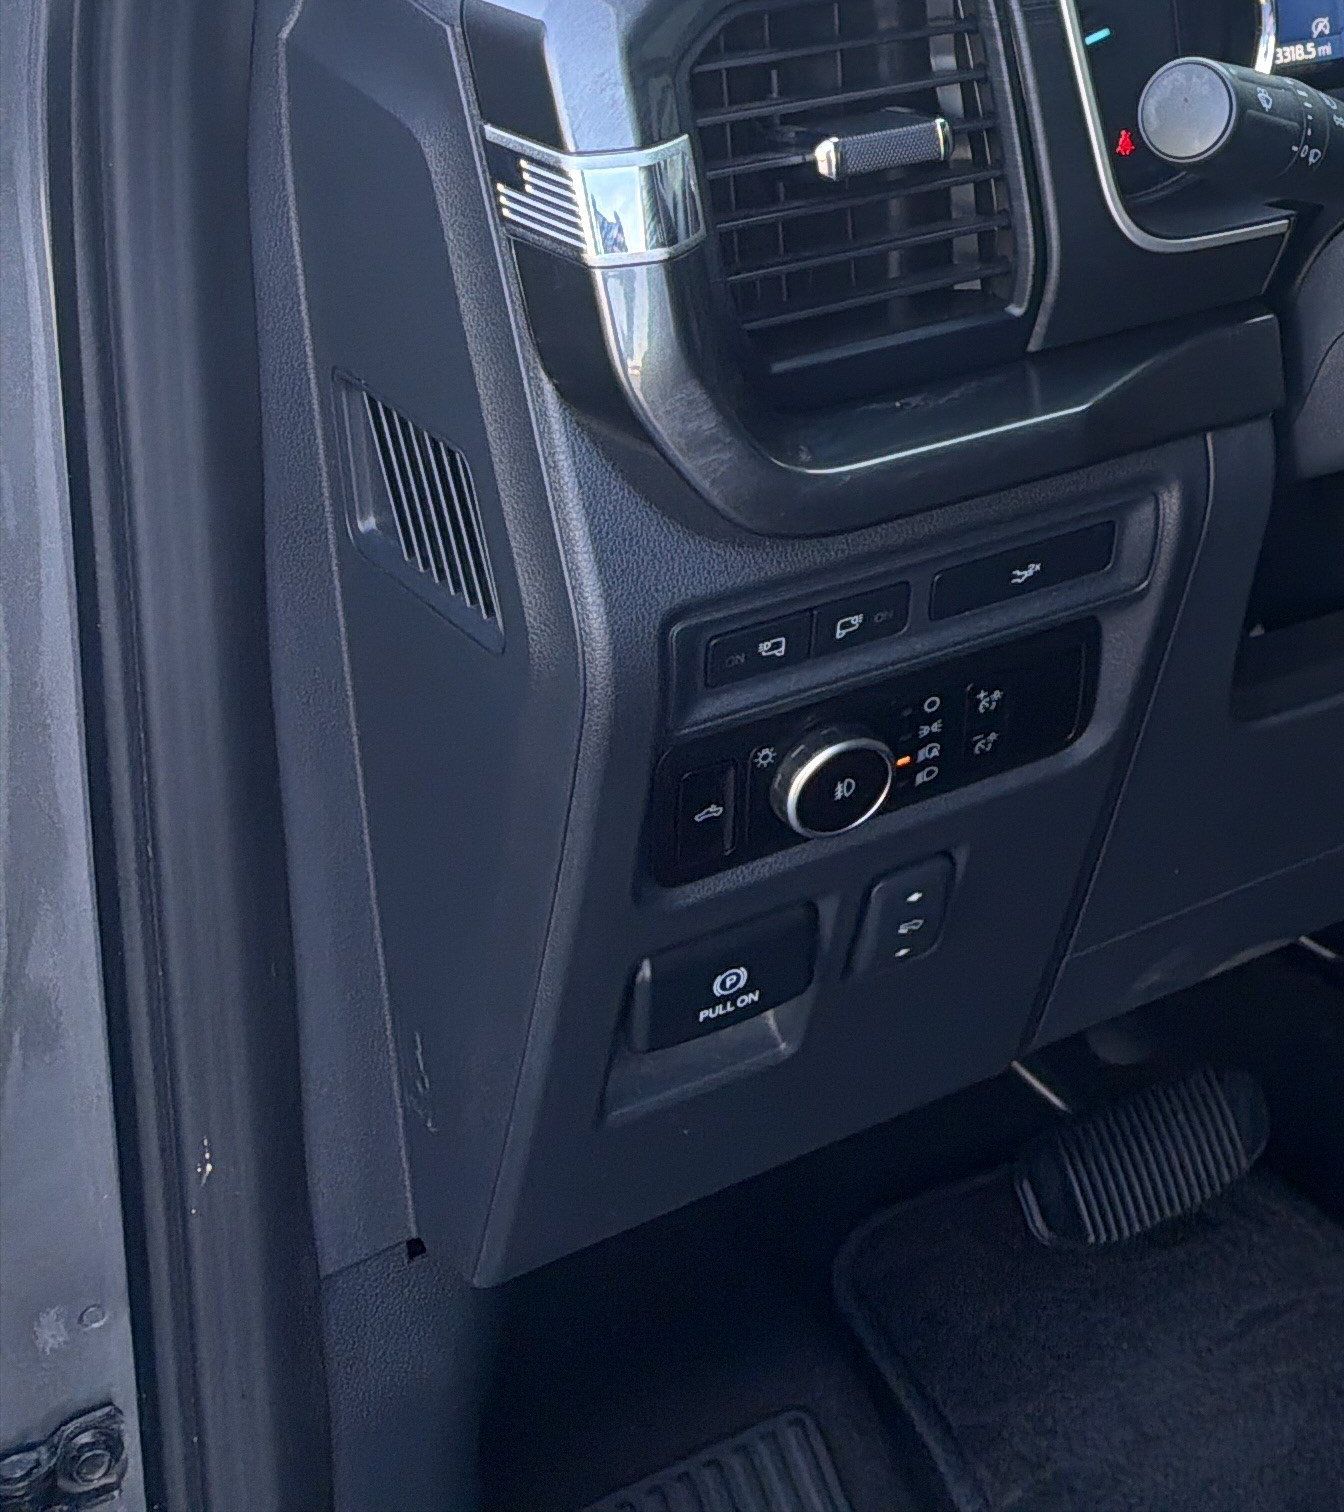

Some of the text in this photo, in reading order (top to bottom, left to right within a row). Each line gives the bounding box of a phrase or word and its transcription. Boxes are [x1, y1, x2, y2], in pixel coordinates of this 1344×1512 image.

[1275, 43, 1333, 65] 3318.5 mi
[874, 609, 894, 623] ON
[725, 653, 746, 668] ON
[699, 990, 759, 1022] PULL ON
